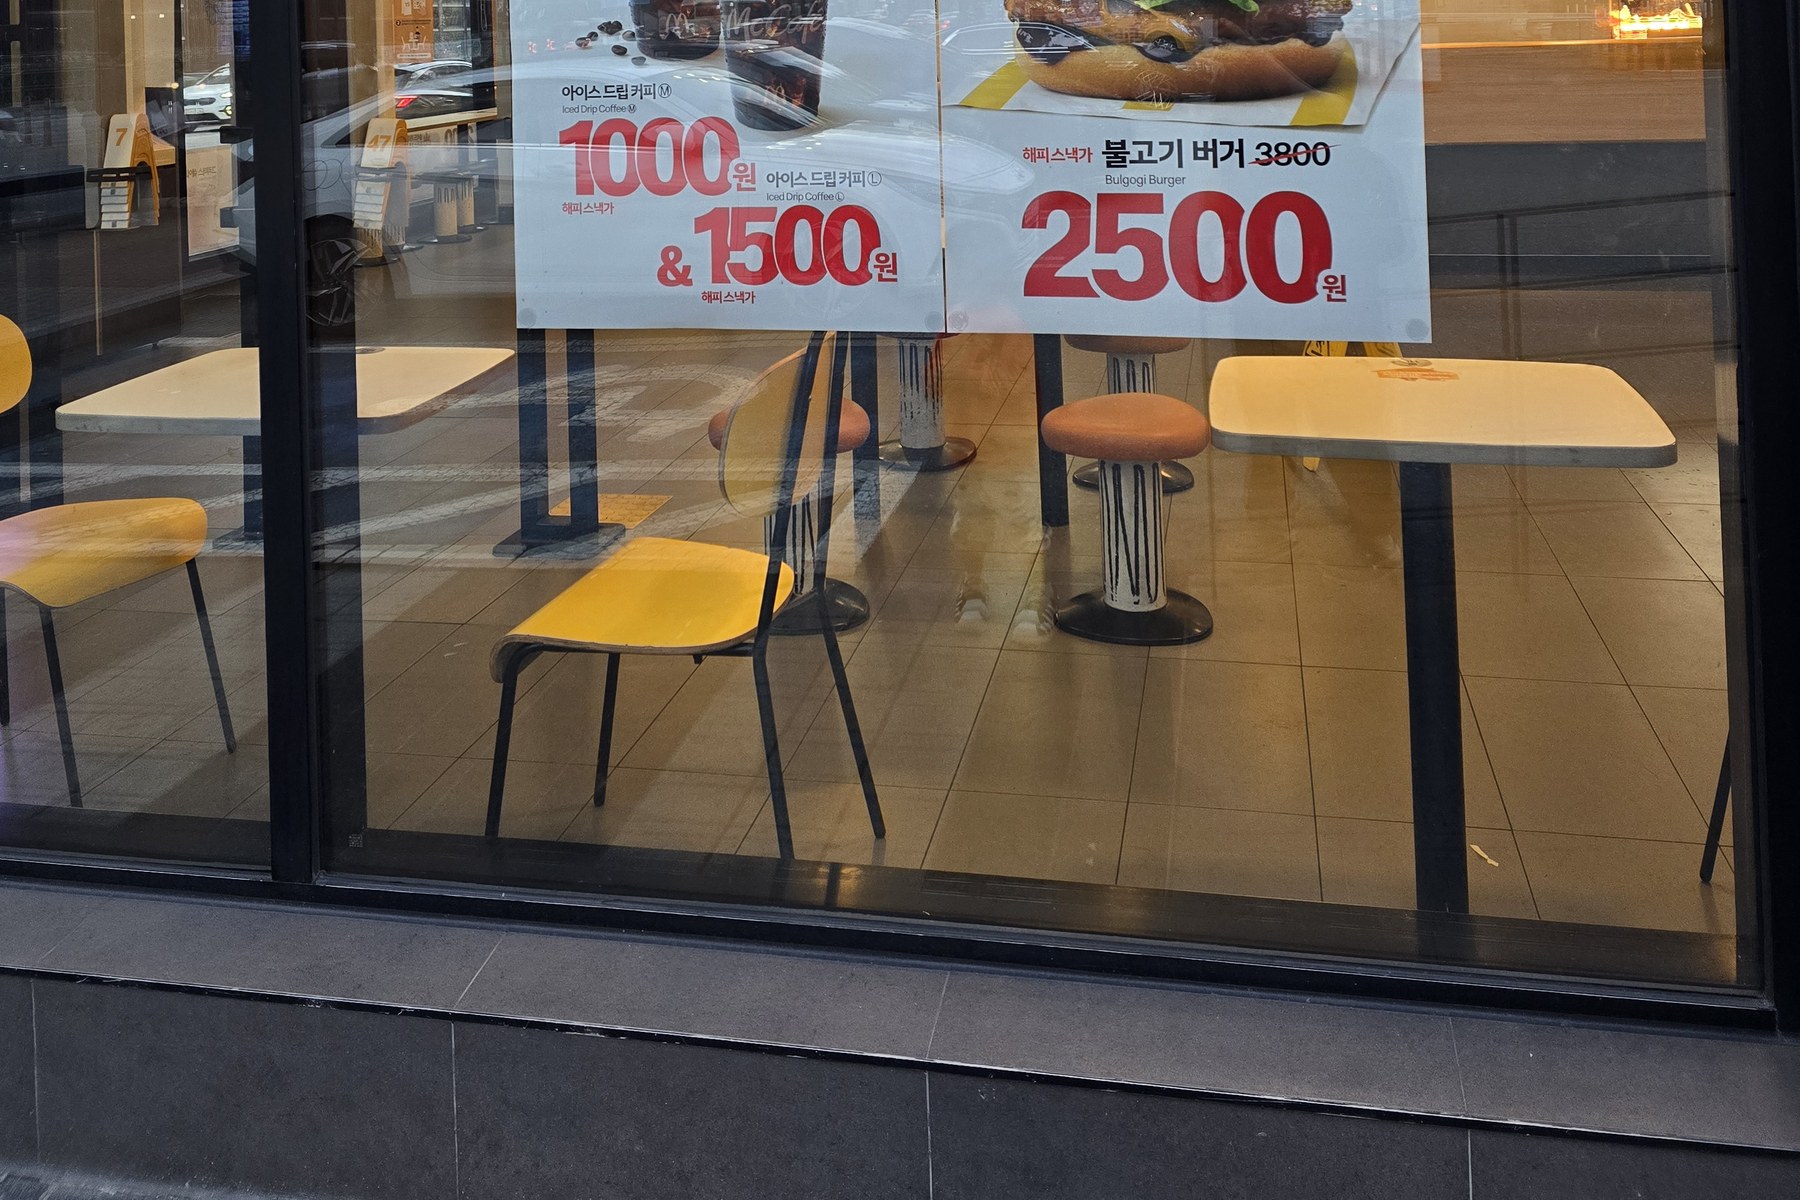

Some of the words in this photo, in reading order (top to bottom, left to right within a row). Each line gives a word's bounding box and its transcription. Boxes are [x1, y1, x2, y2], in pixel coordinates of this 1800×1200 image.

[561, 85, 602, 101] 아이스
[603, 84, 629, 100] 드립
[562, 104, 580, 114] Iced
[581, 104, 598, 115] Drip
[599, 104, 627, 113] Coffee
[115, 128, 129, 147] 7
[366, 134, 392, 149] 47
[1102, 138, 1184, 169] 불고기
[1192, 138, 1246, 169] 버거
[1254, 141, 1332, 167] 3800
[766, 171, 809, 188] 아이스
[810, 171, 837, 188] 드립
[1105, 174, 1148, 188] Bulgogi
[1148, 175, 1187, 188] Burger
[766, 192, 785, 201] Iced
[786, 192, 804, 202] Drip
[804, 191, 835, 201] Coffee
